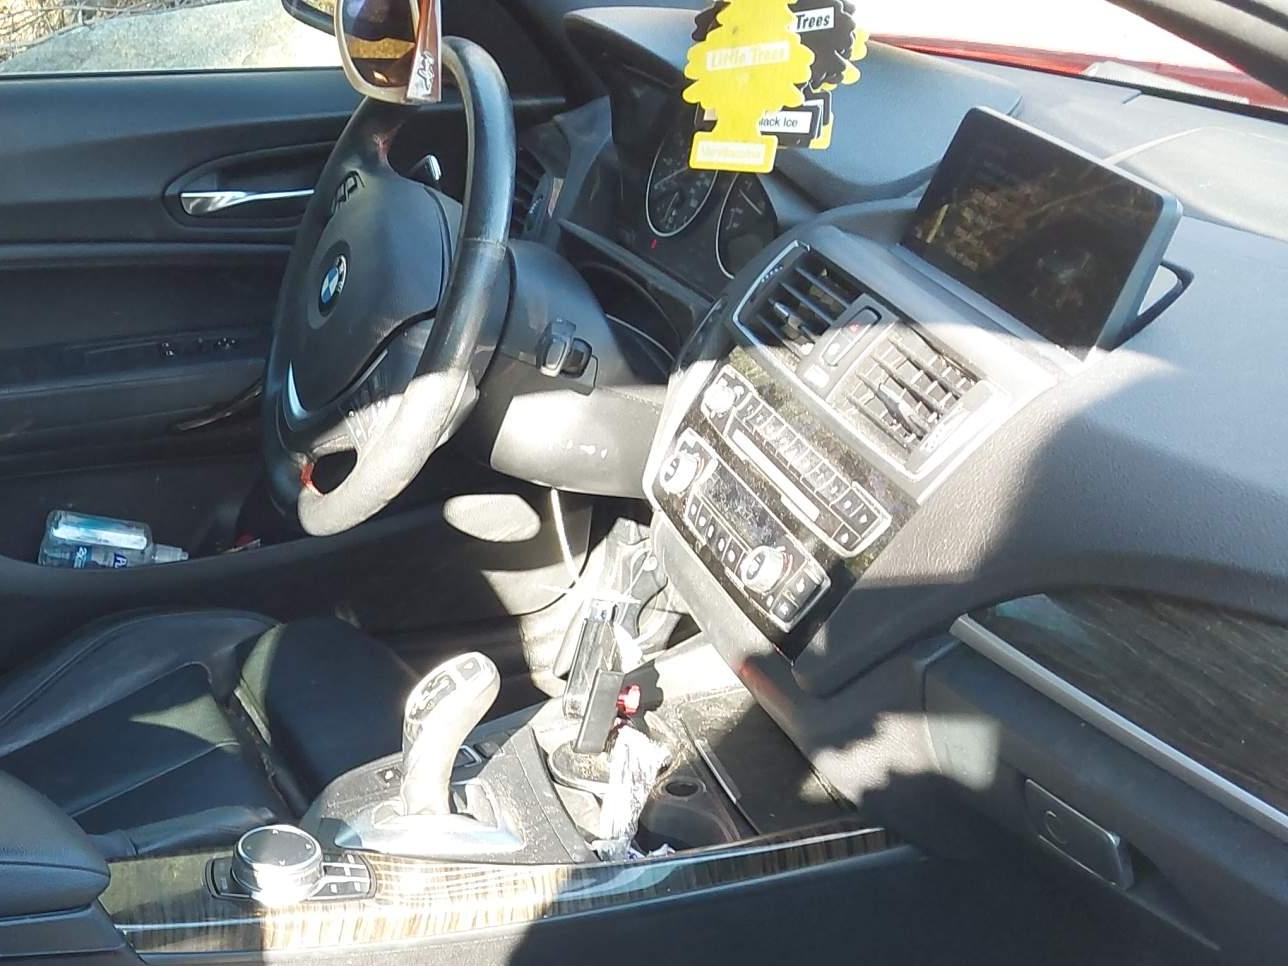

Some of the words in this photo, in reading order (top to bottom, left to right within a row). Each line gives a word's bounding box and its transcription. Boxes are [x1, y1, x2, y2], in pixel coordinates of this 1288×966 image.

[795, 14, 831, 30] Trees
[758, 116, 780, 128] lack
[783, 116, 798, 128] Ice
